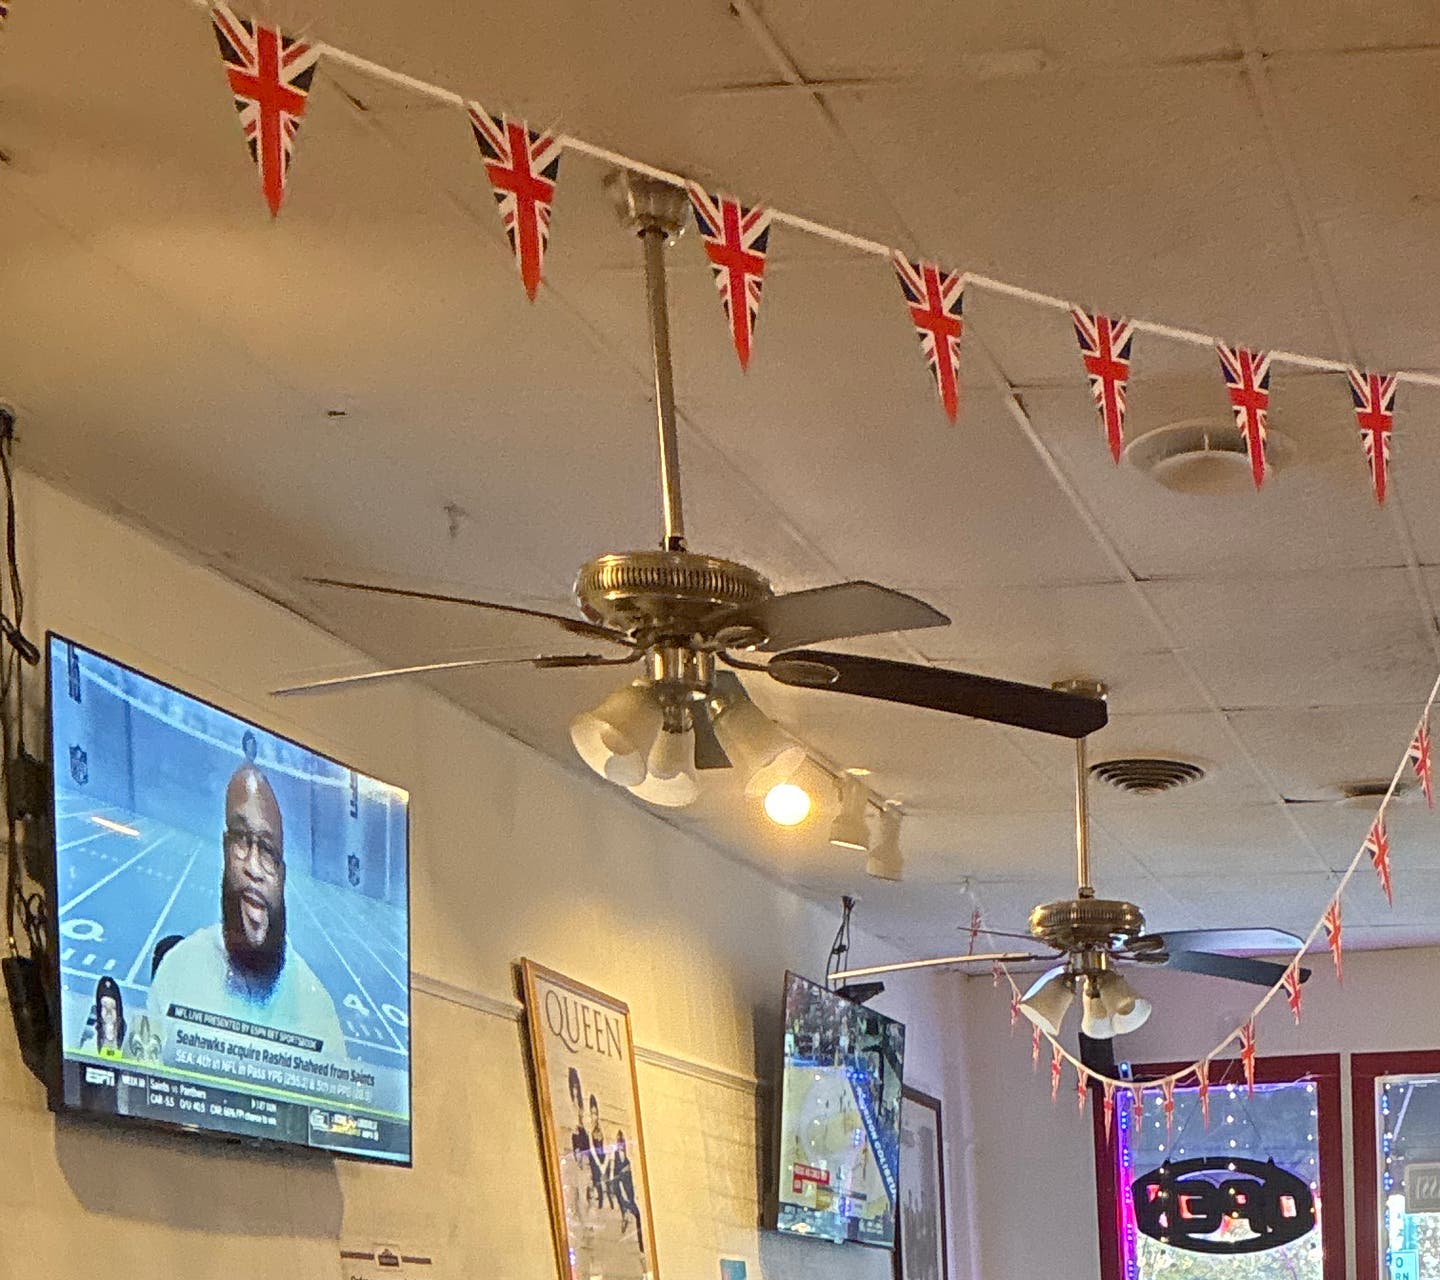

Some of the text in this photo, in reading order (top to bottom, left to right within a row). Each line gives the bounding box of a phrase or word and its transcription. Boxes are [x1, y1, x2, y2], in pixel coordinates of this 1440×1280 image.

[545, 989, 623, 1061] QUEEN
[85, 1067, 115, 1087] ESPN
[176, 1029, 375, 1086] Seahawks acquire Rashid Shaheed from Saints
